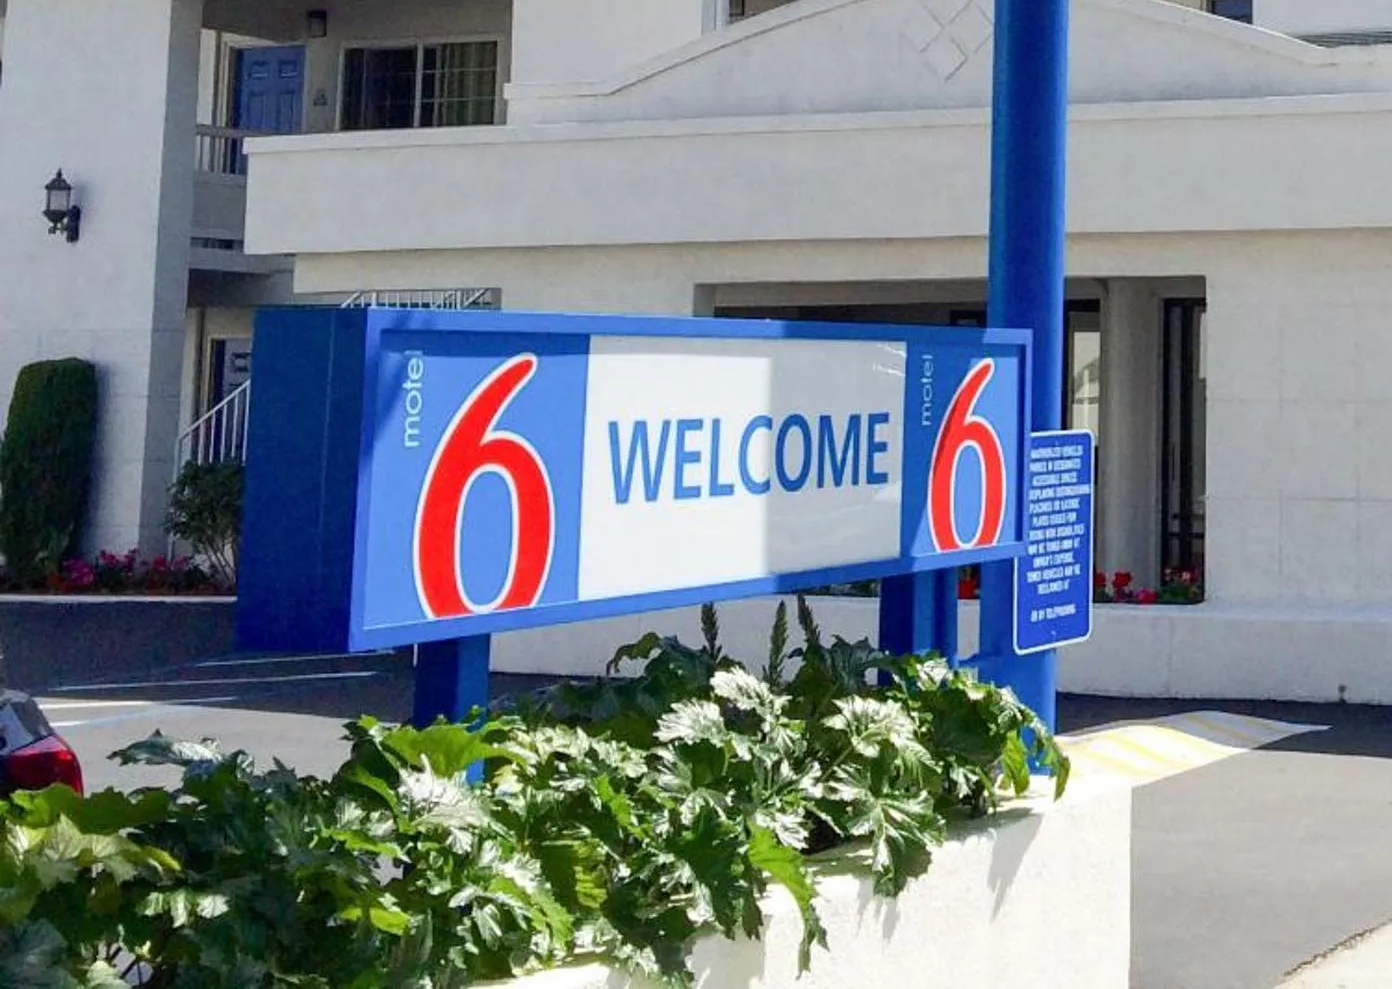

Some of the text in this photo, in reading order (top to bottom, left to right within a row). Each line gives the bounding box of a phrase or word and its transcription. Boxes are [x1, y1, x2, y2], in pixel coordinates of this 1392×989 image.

[402, 350, 555, 619] motel 6
[607, 412, 890, 505] WELCOME
[920, 354, 1007, 553] motel 6
